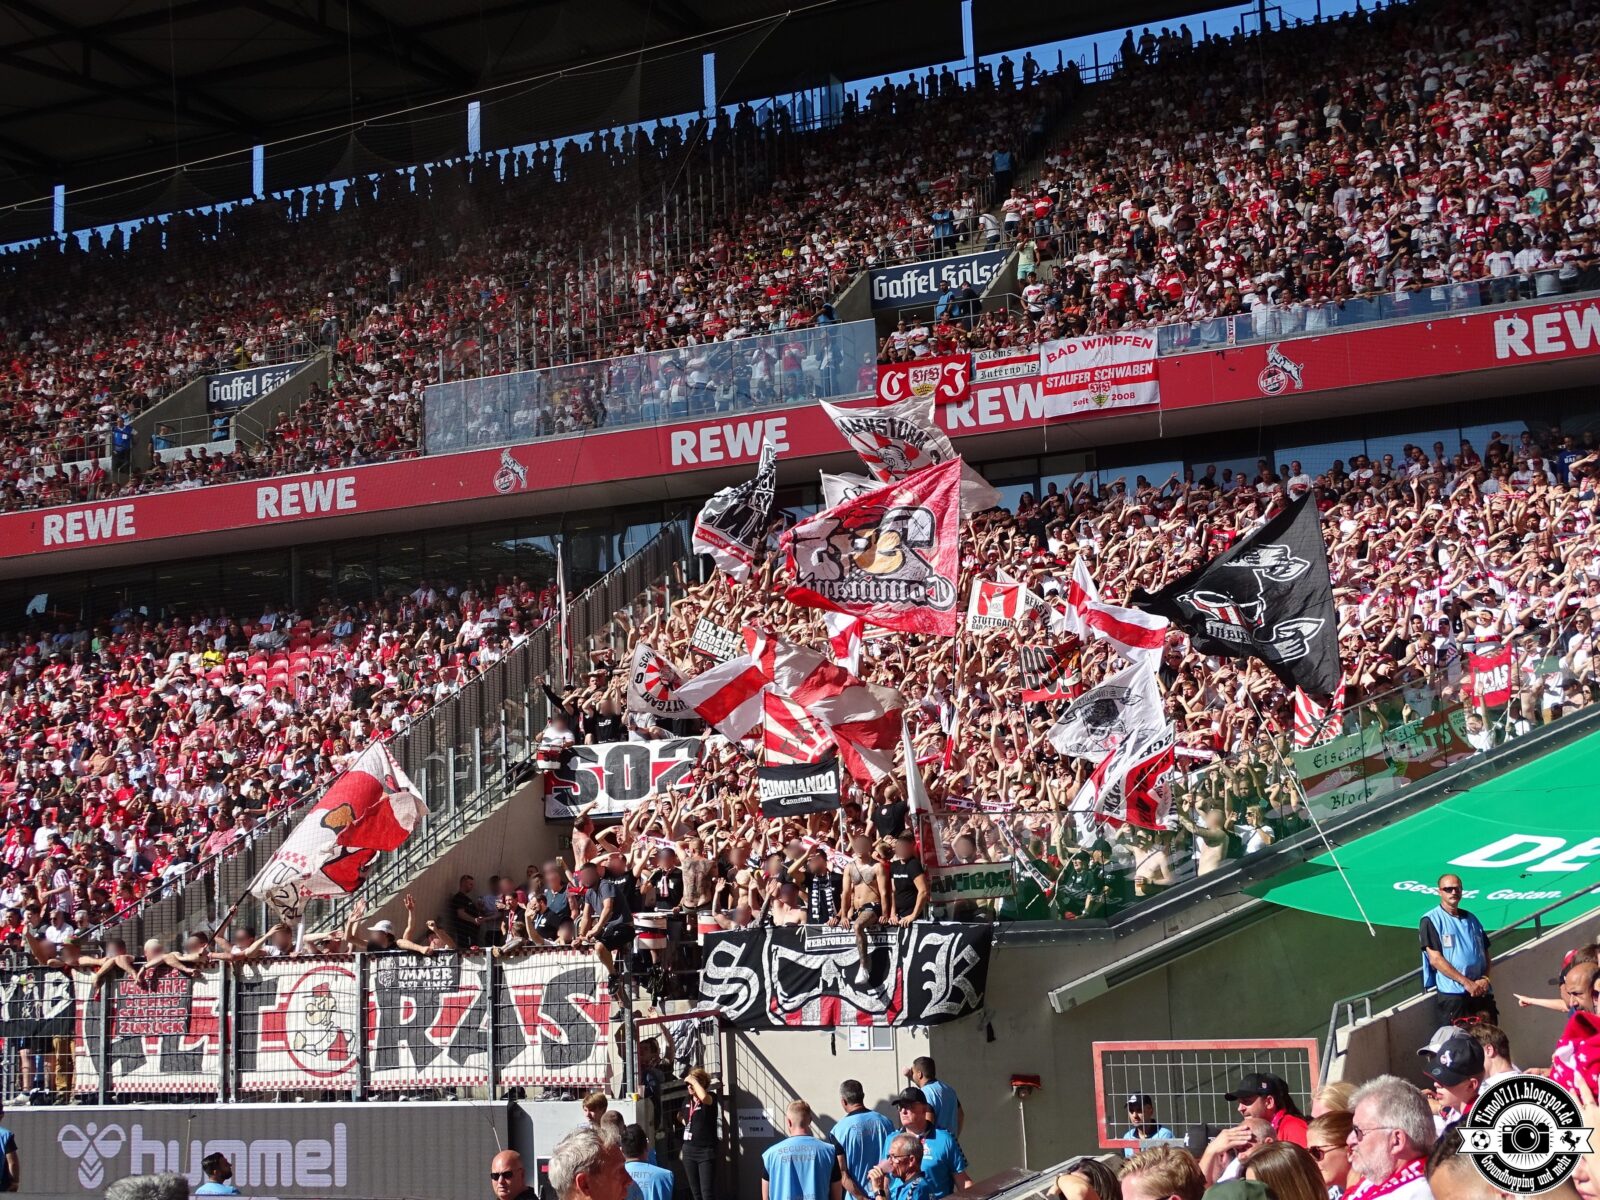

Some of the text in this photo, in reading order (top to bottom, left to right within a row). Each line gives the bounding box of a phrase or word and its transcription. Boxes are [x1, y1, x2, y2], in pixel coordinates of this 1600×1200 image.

[873, 266, 939, 301] Gaffel
[1046, 335, 1153, 364] BAD WIMPFEN
[980, 365, 1021, 380] Inferno
[1046, 361, 1154, 389] STAUFER SCHWABEN
[208, 373, 258, 403] Gaffel
[1073, 391, 1136, 407] seit 2008
[671, 416, 790, 466] REWE
[256, 477, 358, 520] REWE
[43, 504, 136, 546] REWE
[759, 771, 835, 800] COMMANDO
[398, 955, 418, 967] DU
[398, 967, 453, 981] IMMER
[131, 1122, 347, 1188] hummel
